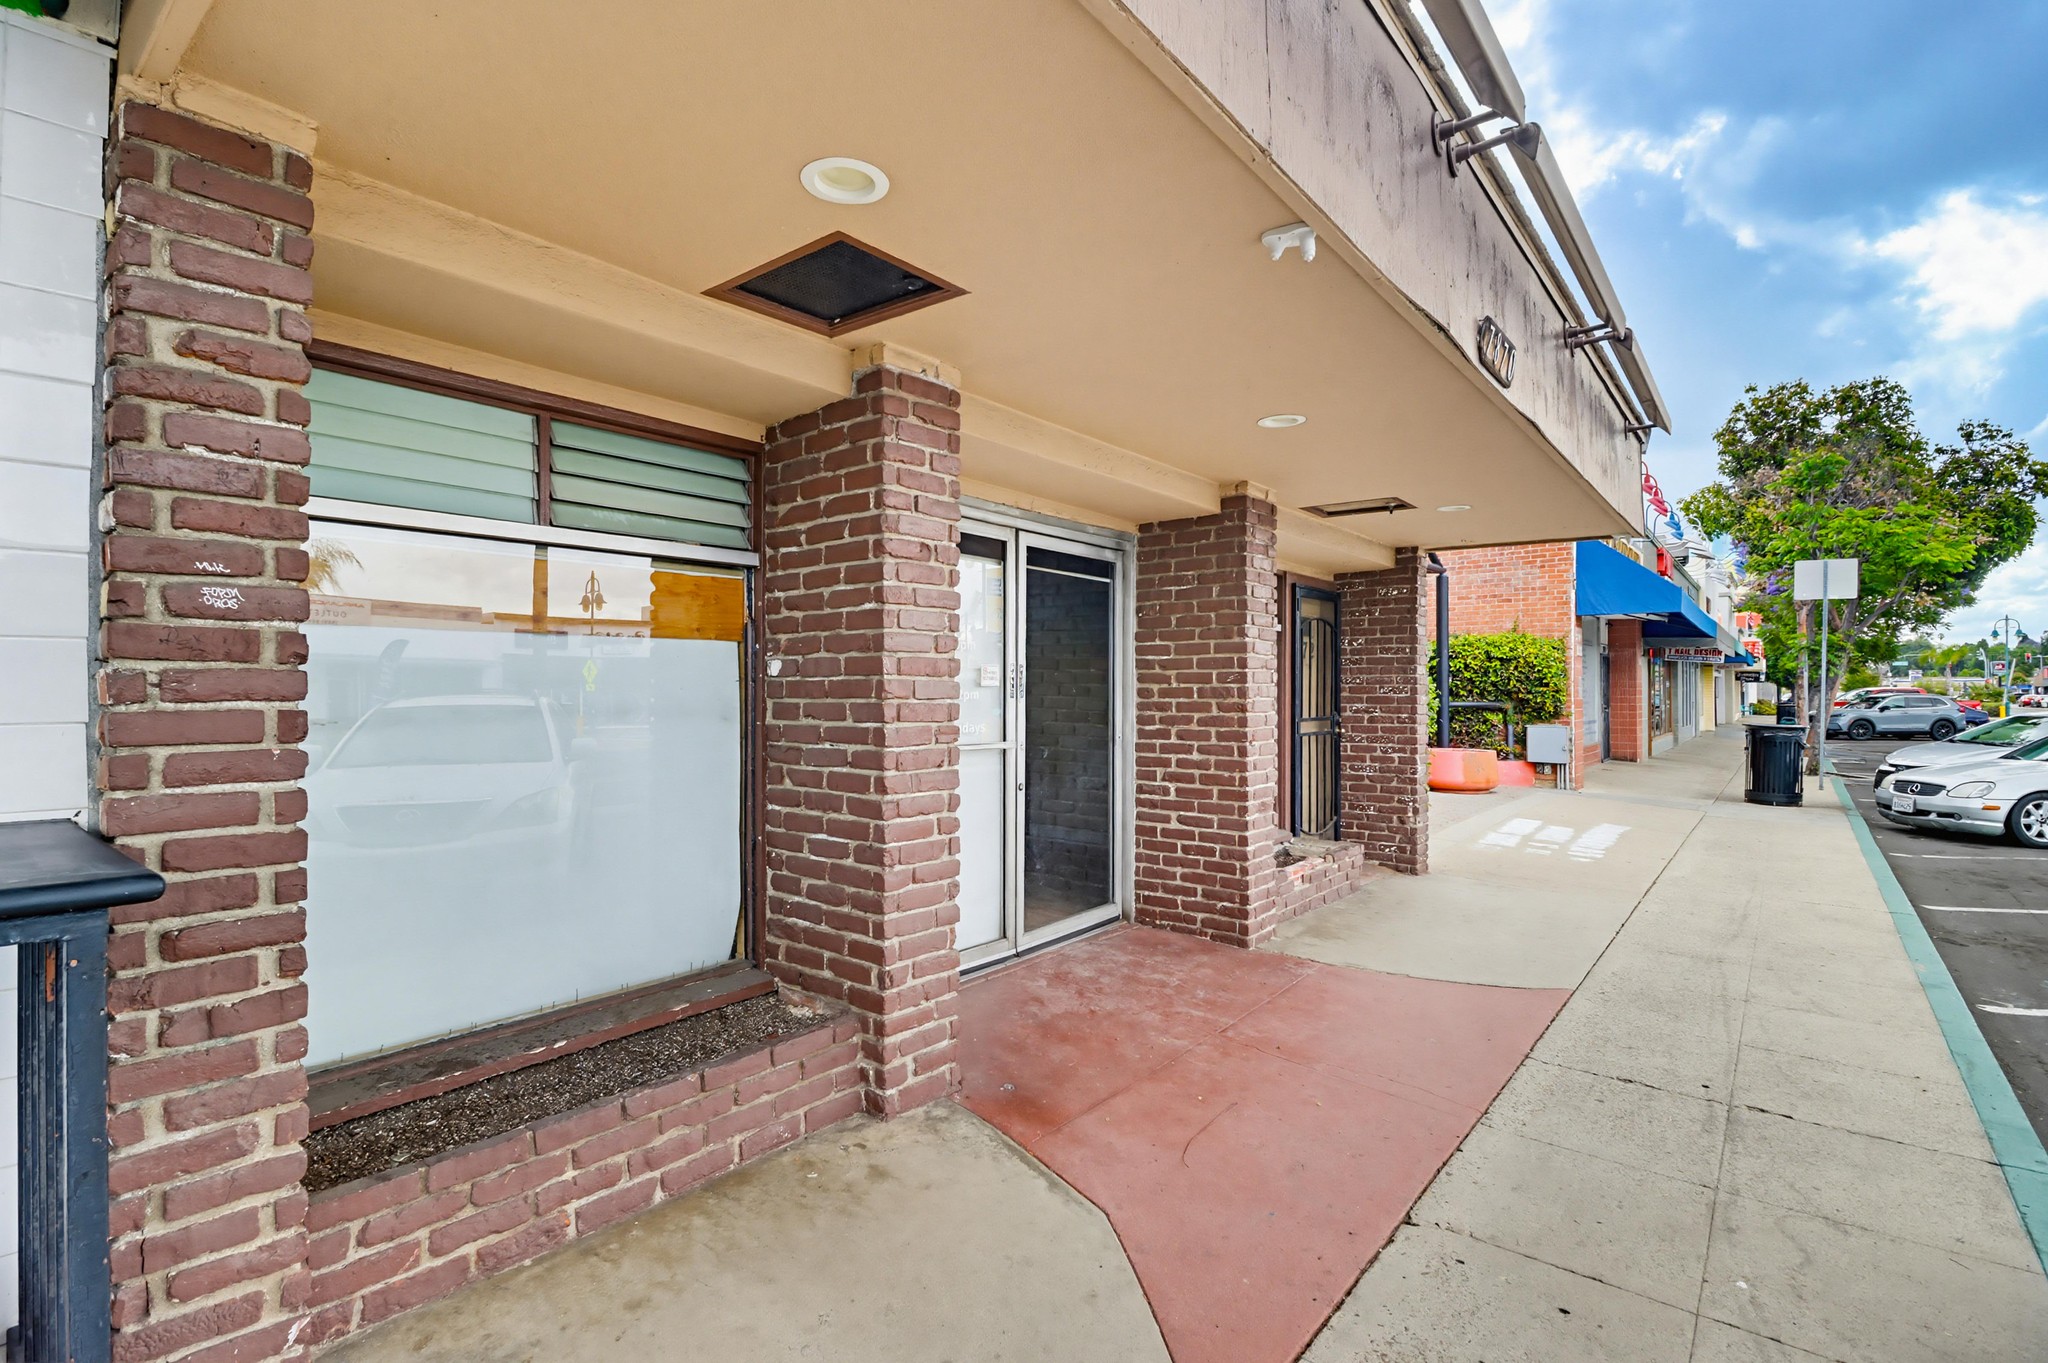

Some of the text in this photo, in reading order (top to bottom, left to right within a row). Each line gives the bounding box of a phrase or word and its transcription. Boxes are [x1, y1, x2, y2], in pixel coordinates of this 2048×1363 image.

[1486, 324, 1517, 381] 7870
[1674, 648, 1692, 656] NAIL
[1694, 648, 1723, 657] DESIGN
